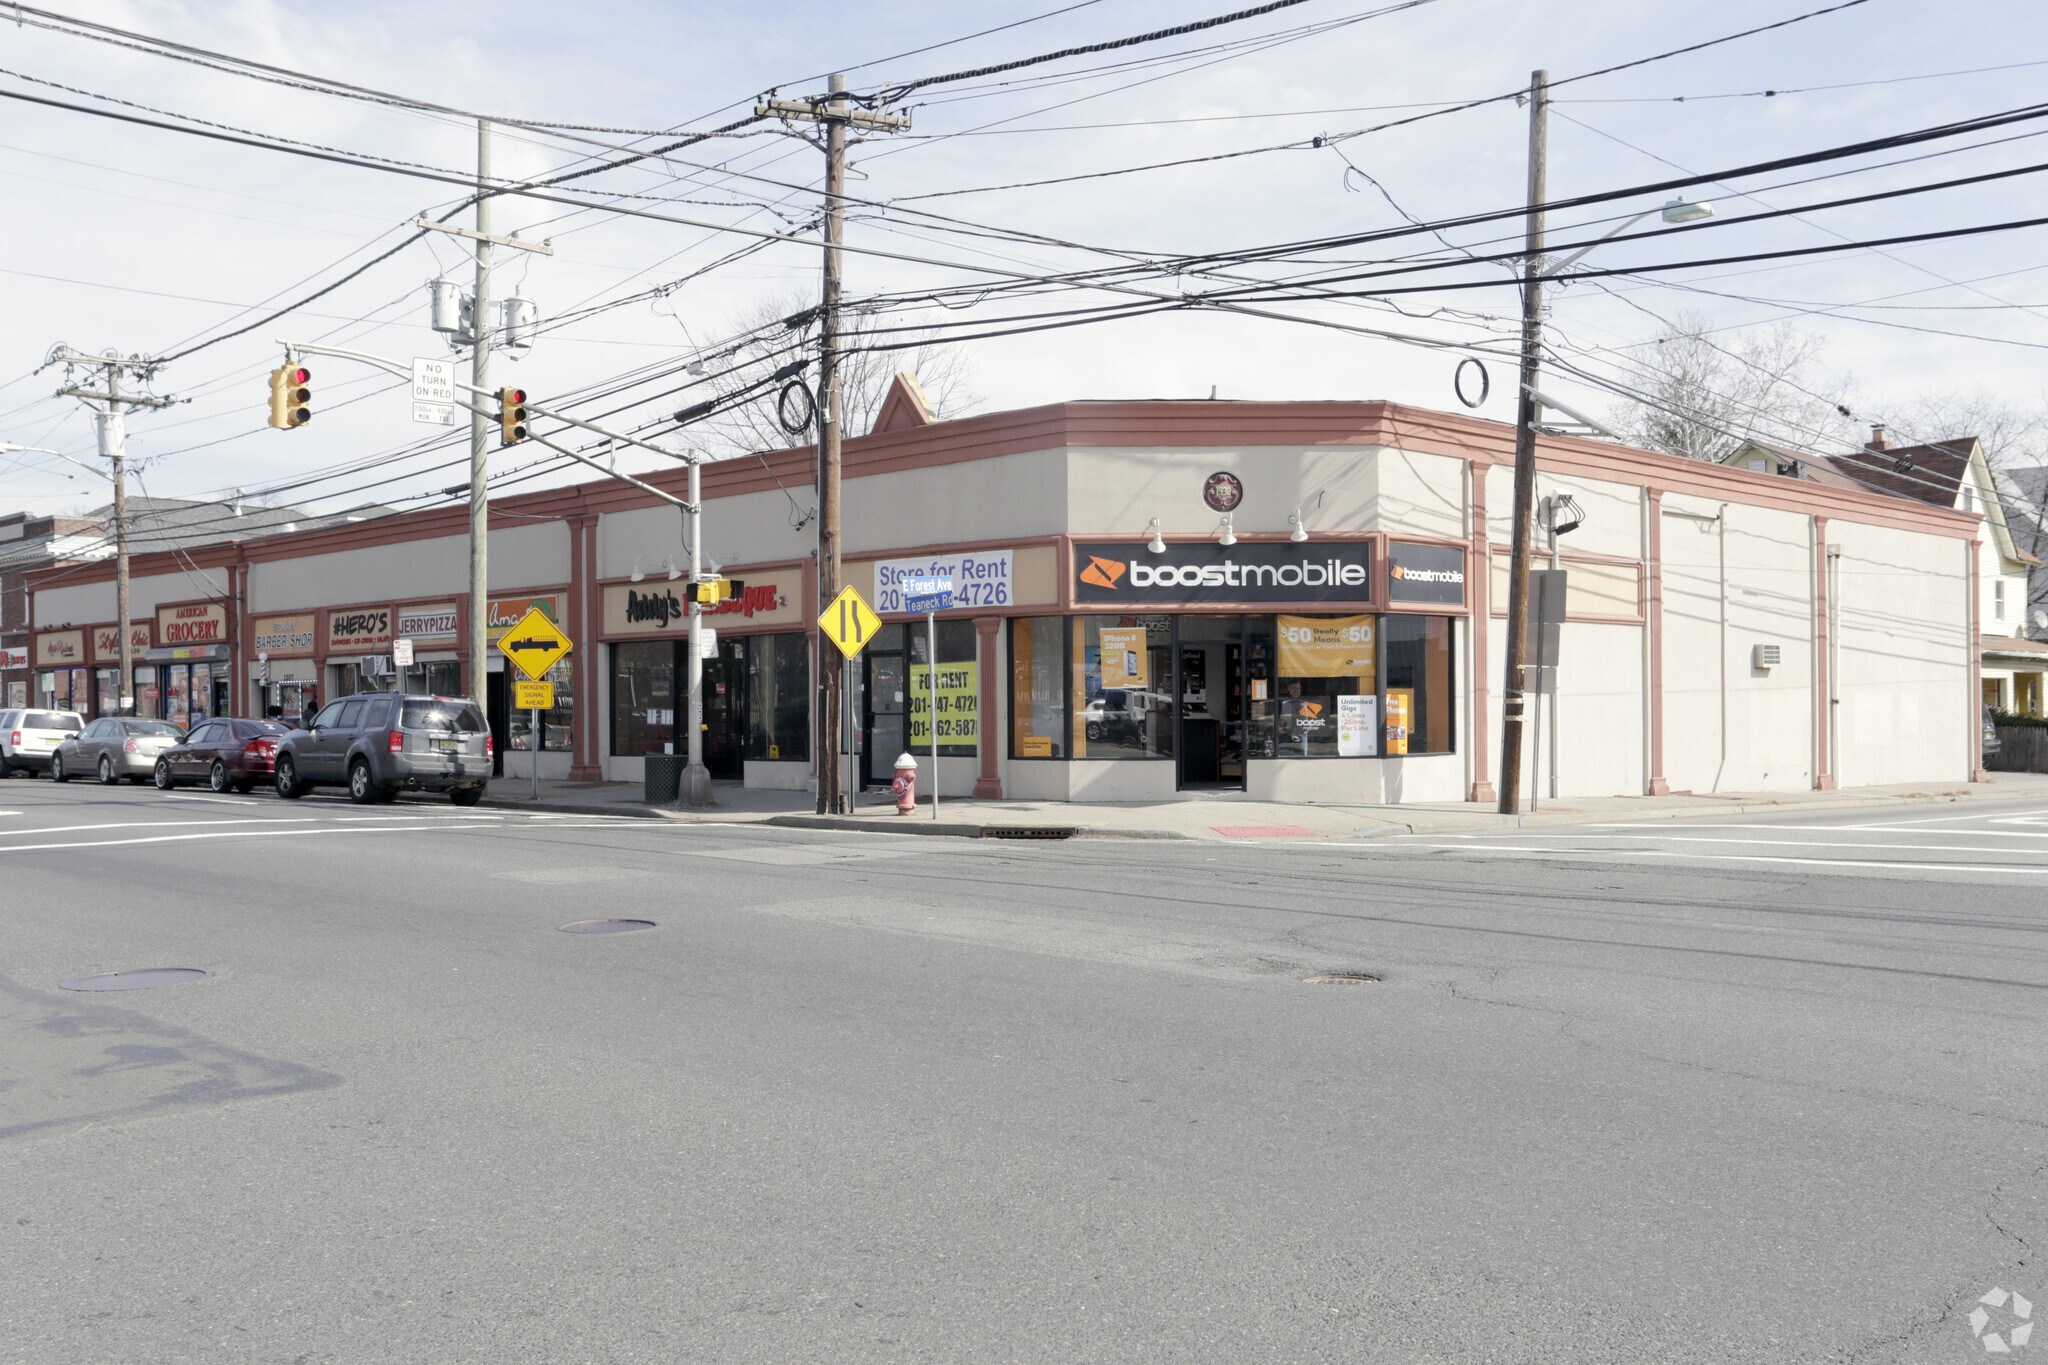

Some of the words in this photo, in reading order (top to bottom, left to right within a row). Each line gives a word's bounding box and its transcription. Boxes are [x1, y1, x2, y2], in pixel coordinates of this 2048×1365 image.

[426, 364, 441, 373] NO
[422, 375, 446, 386] TURN
[416, 387, 429, 395] ON
[433, 389, 452, 398] RED
[961, 557, 1007, 581] Rent
[1130, 560, 1366, 587] boostmobile
[903, 579, 909, 592] E
[910, 578, 936, 592] Forest
[937, 578, 952, 591] Ave
[626, 589, 681, 628] Addy's
[906, 597, 940, 612] Teaneck
[176, 606, 208, 619] AMERICAN
[166, 620, 219, 642] GROCERY
[1280, 627, 1312, 643] $50
[1313, 628, 1339, 636] Really
[1342, 626, 1372, 642] $50
[256, 635, 287, 649] BARBER
[290, 633, 312, 647] SHOP
[919, 673, 939, 690] FOR
[941, 671, 969, 688] RENT
[1296, 718, 1326, 727] boost
